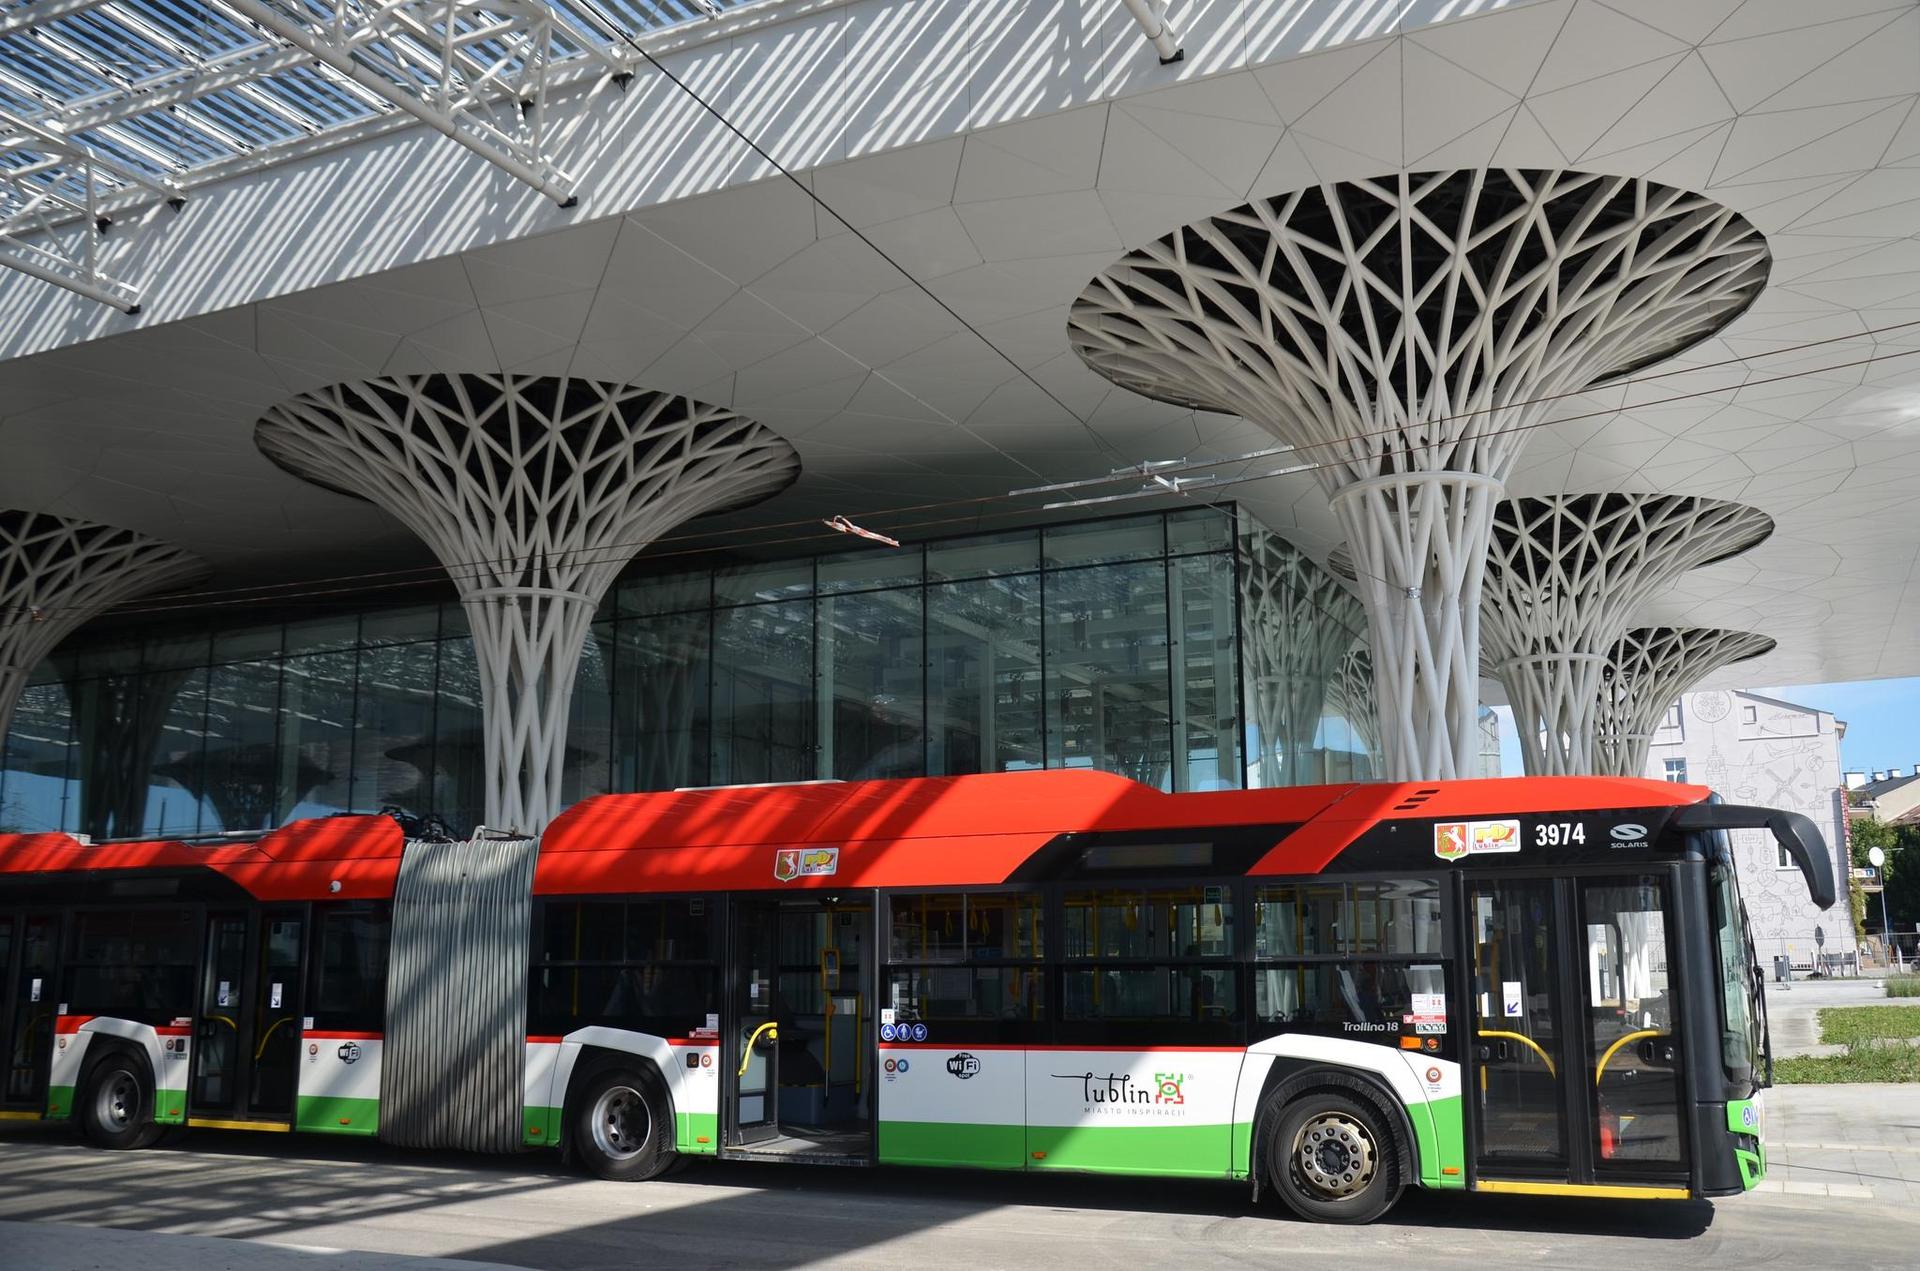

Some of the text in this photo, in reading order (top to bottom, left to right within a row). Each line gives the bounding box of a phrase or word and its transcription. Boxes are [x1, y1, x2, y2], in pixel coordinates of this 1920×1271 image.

[1535, 823, 1585, 846] 3974
[1610, 841, 1649, 849] SOLARIS
[1343, 1021, 1399, 1031] Trollino 18
[1084, 1107, 1185, 1117] MIASTO INSPIRACJI
